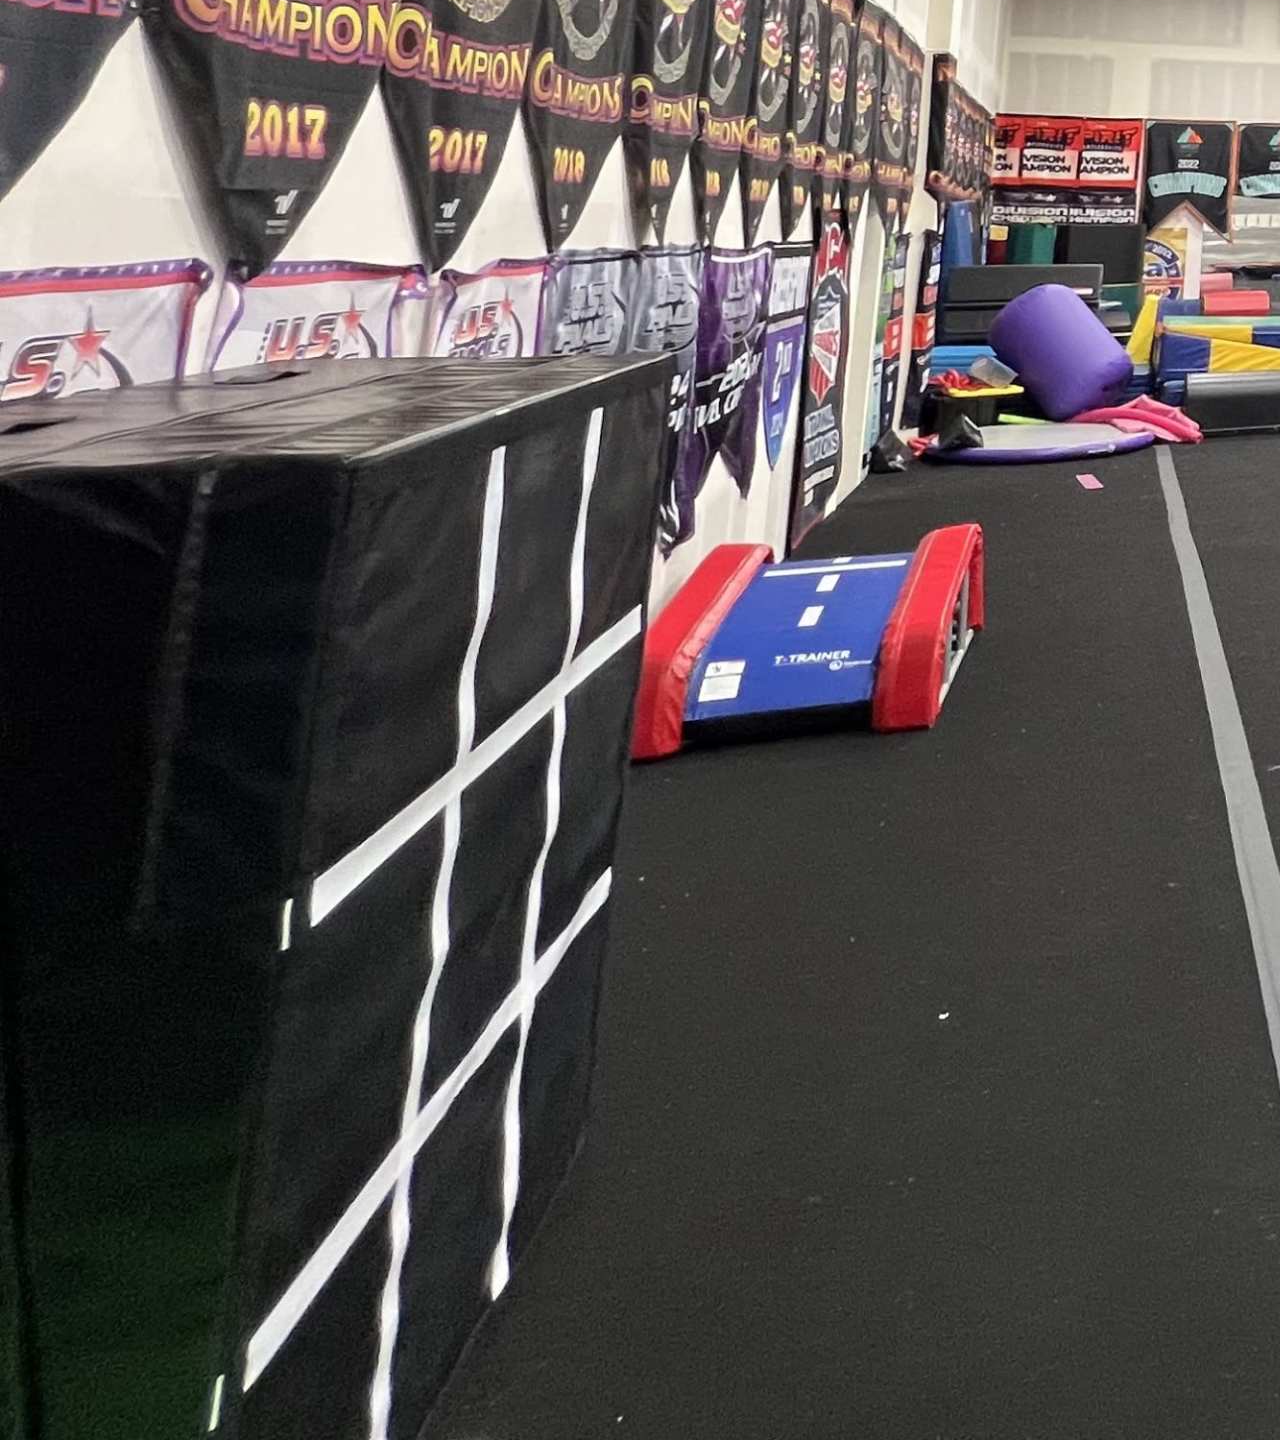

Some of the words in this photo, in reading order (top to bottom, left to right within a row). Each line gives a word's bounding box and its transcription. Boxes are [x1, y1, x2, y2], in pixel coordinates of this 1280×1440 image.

[244, 97, 328, 160] 2017
[428, 126, 489, 175] 2017
[1024, 154, 1066, 164] VISION
[1081, 156, 1124, 166] VISION
[1022, 163, 1072, 173] AMPION
[1080, 165, 1130, 175] AMPION
